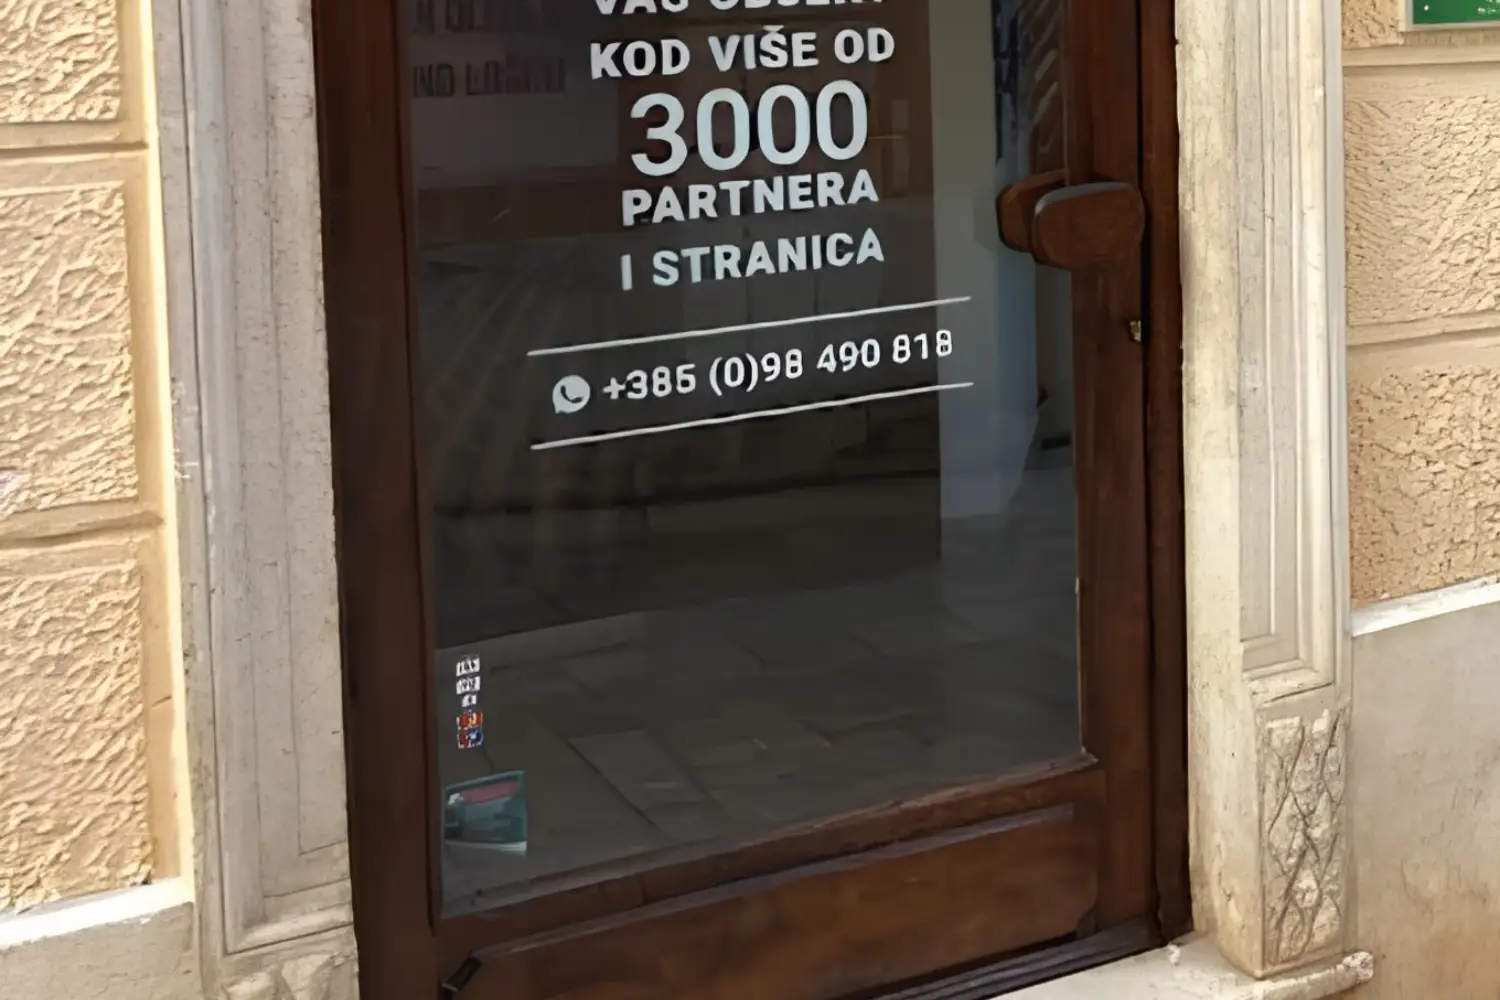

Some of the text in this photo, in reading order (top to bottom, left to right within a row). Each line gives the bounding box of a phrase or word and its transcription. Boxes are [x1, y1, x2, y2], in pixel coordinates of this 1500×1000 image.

[590, 37, 691, 80] KOD
[707, 24, 819, 72] VIŠE
[834, 27, 896, 64] OD
[630, 79, 870, 177] 3000
[622, 168, 880, 226] PARTNERA
[621, 227, 885, 291] I STRANICA
[602, 329, 953, 401] +385 (0)98 490 818
